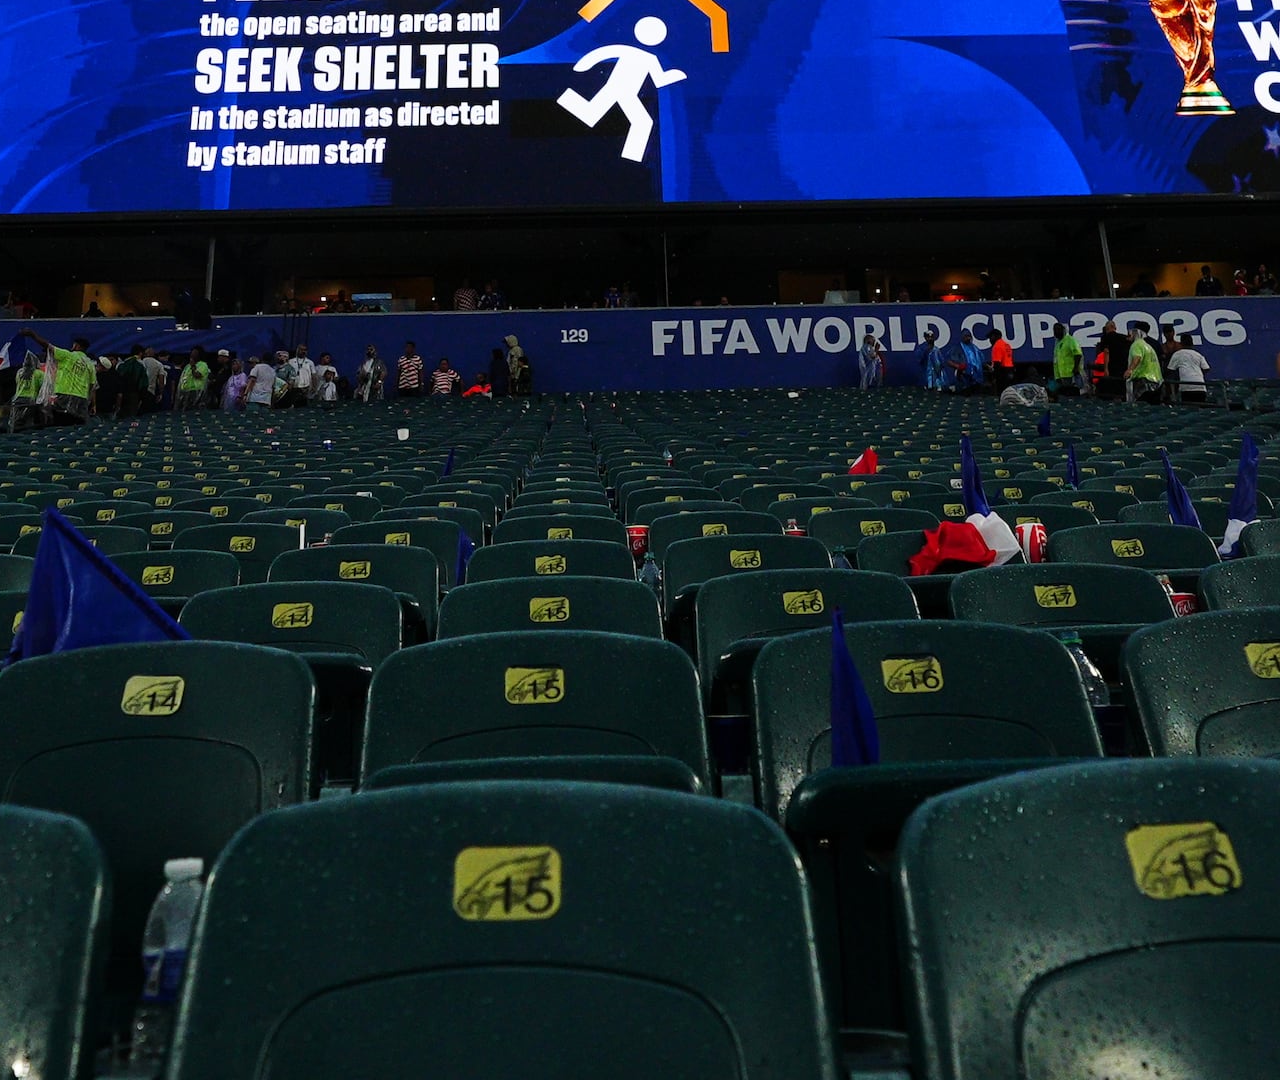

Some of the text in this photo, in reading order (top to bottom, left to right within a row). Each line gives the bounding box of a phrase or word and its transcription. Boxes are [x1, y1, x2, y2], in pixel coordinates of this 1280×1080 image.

[199, 8, 500, 41] the open seating area and
[194, 43, 500, 93] SEEK SHELTER
[190, 100, 500, 130] in the stadium as directed
[187, 138, 386, 171] by stadium staff
[560, 328, 589, 345] 129
[651, 309, 1248, 356] FIFA WORLD CUP 2026
[1125, 545, 1142, 555] 18
[548, 563, 565, 573] 15
[743, 557, 760, 567] 16
[154, 573, 171, 583] 13
[351, 567, 367, 577] 14
[799, 598, 823, 612] 16
[1050, 592, 1072, 605] 17
[288, 612, 308, 626] 14
[545, 606, 567, 620] 15
[906, 670, 939, 690] 16
[528, 679, 561, 700] 15
[147, 690, 178, 712] 14
[1178, 850, 1229, 890] 16
[496, 873, 554, 914] 15
